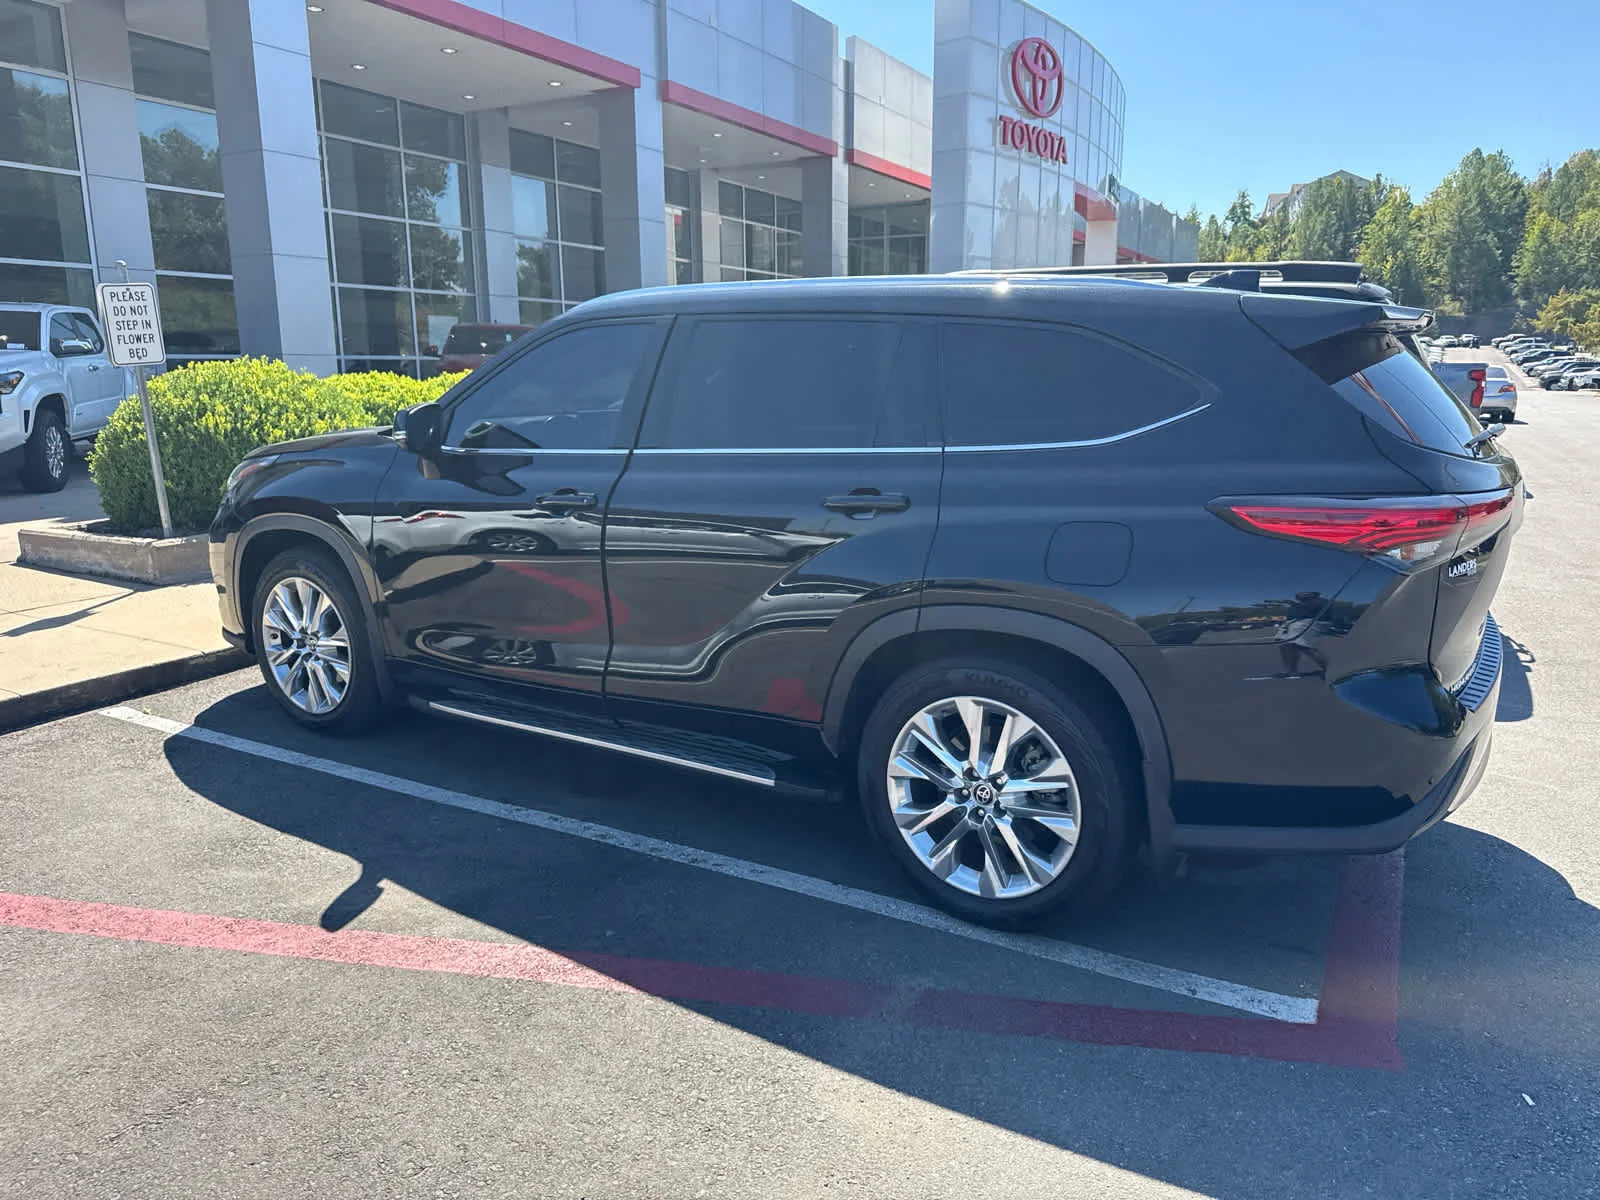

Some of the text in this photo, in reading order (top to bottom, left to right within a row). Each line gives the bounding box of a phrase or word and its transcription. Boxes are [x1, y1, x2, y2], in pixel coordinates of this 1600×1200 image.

[999, 115, 1067, 164] TOYOTA
[110, 291, 147, 302] PLEASE
[113, 305, 148, 316] DO NOT
[116, 319, 152, 331] STEP IN
[117, 333, 155, 344] FLOWER
[129, 348, 148, 359] BED
[1449, 558, 1476, 577] LANDERS
